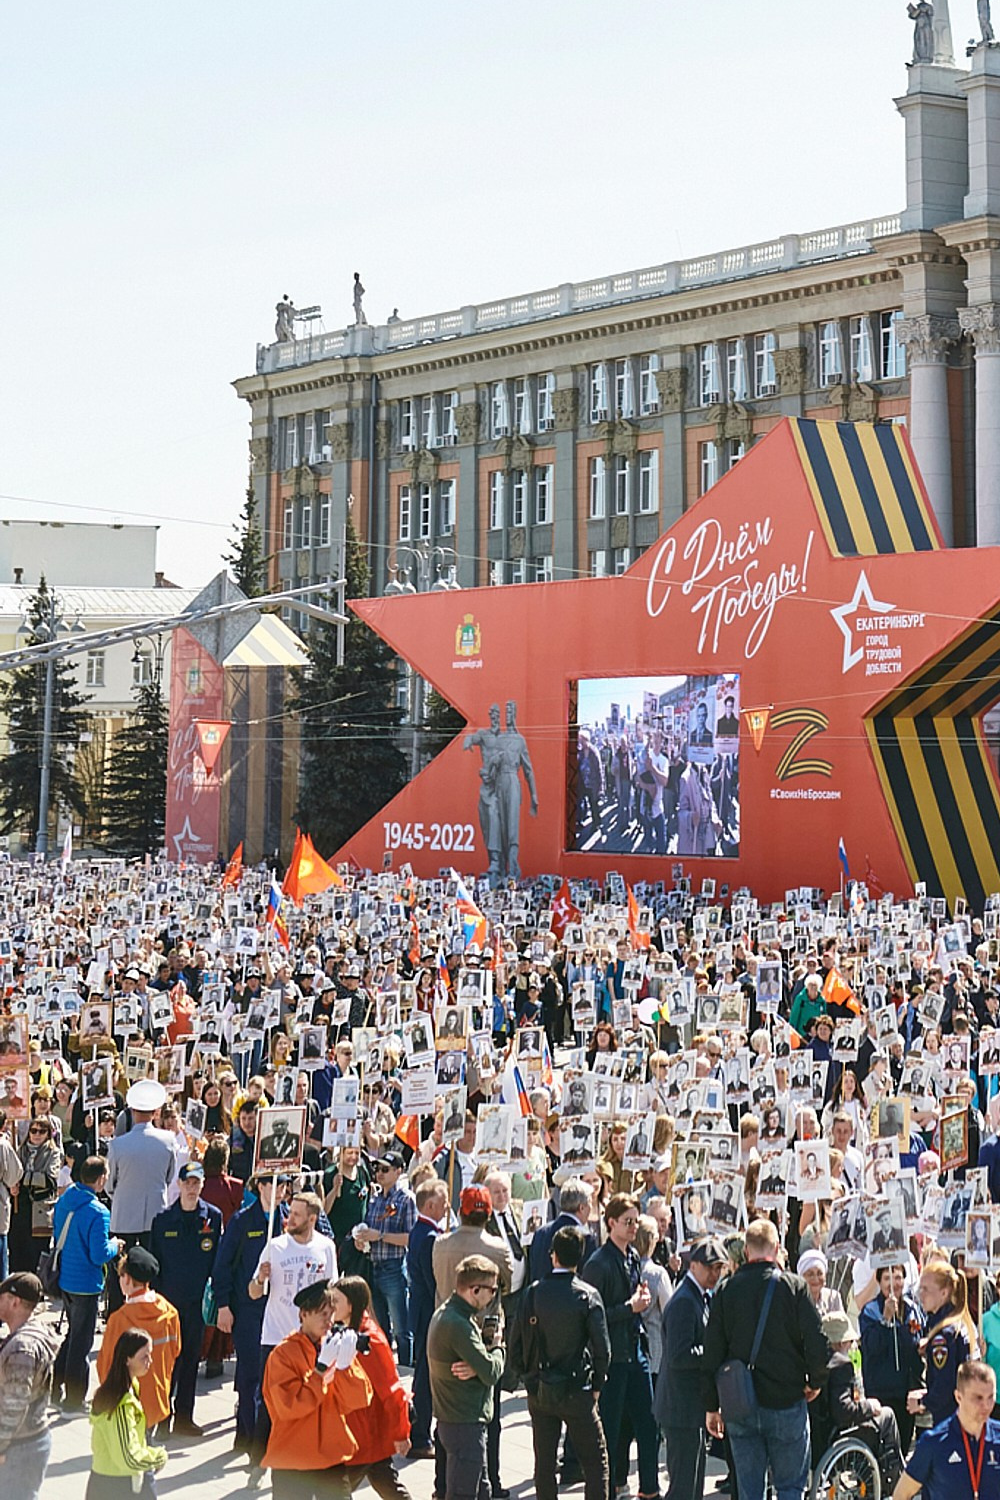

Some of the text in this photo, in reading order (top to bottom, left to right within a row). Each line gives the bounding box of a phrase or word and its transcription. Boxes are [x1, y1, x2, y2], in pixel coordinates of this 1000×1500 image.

[647, 517, 774, 617] С Днём
[691, 530, 814, 658] Победы!
[856, 613, 926, 631] ЕКАТЕРИНБУРГ
[866, 634, 888, 647] ГОРОД
[866, 646, 901, 661] ТРУДОВОЙ
[769, 707, 834, 781] Z
[383, 822, 475, 852] 1945-2022
